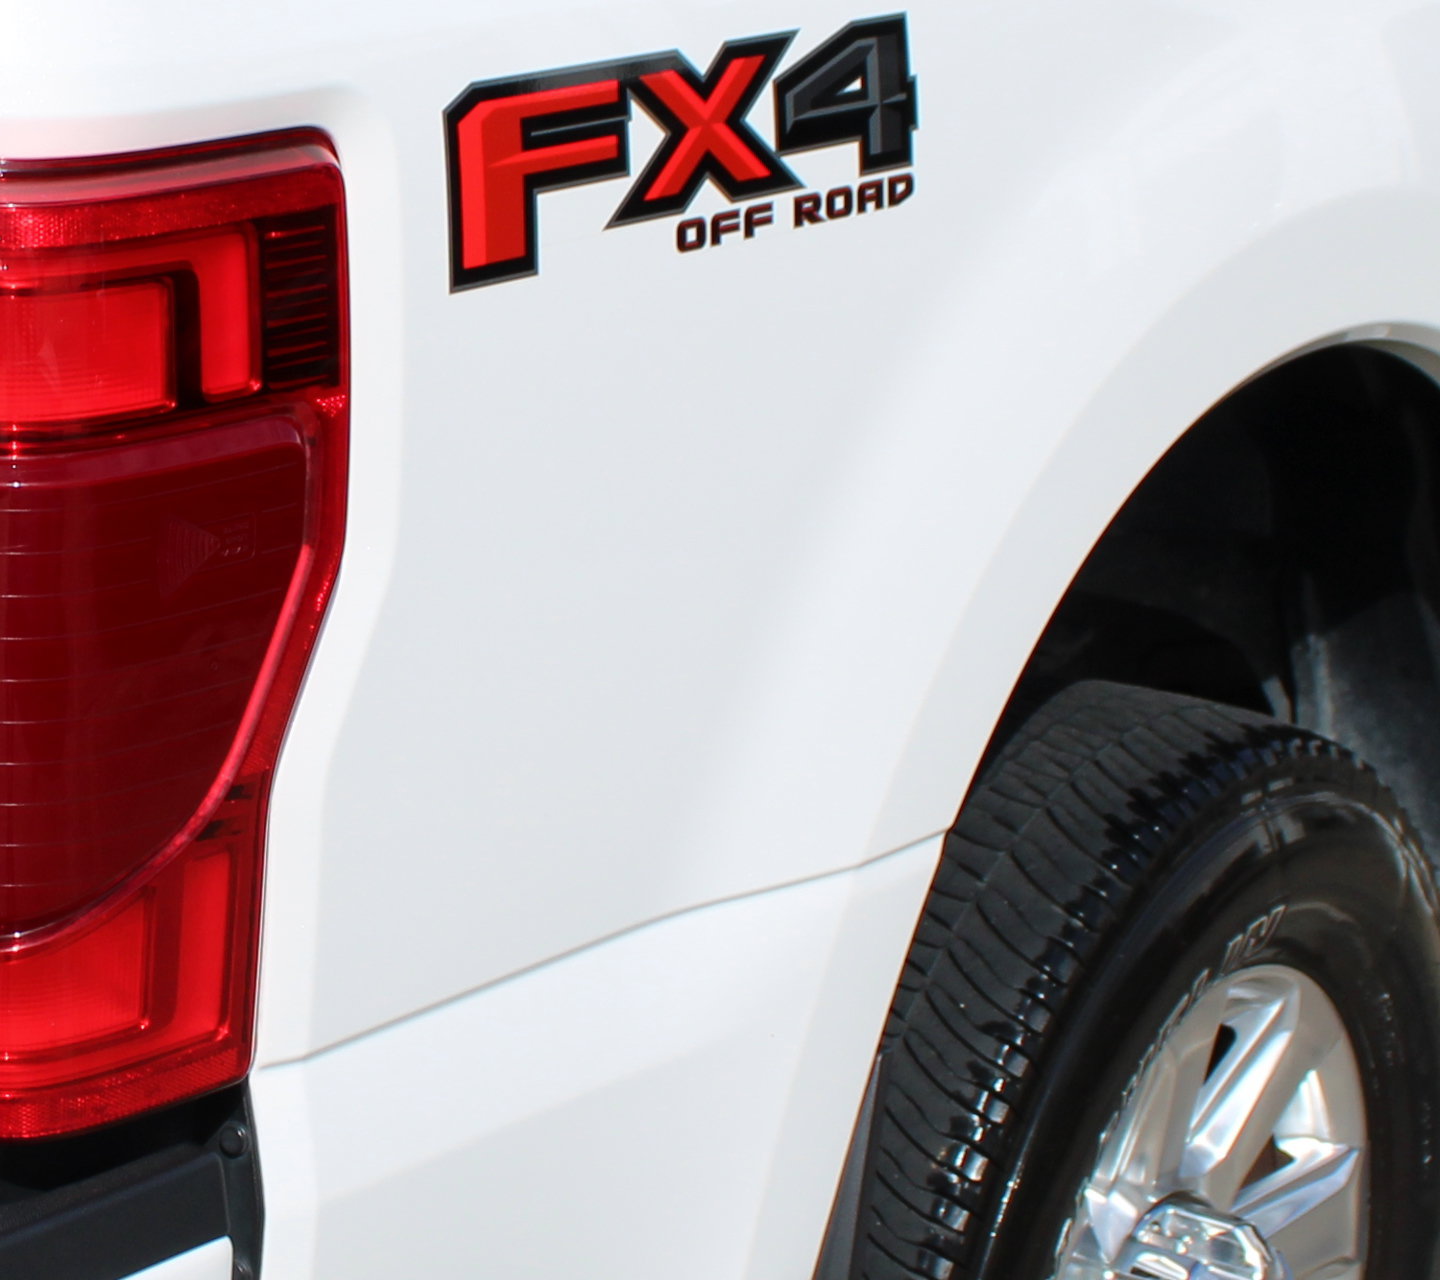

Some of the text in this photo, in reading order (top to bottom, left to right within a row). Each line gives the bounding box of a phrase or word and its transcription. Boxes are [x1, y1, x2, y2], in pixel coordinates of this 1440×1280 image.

[442, 11, 918, 295] FX4
[676, 173, 914, 253] OFF ROAD
